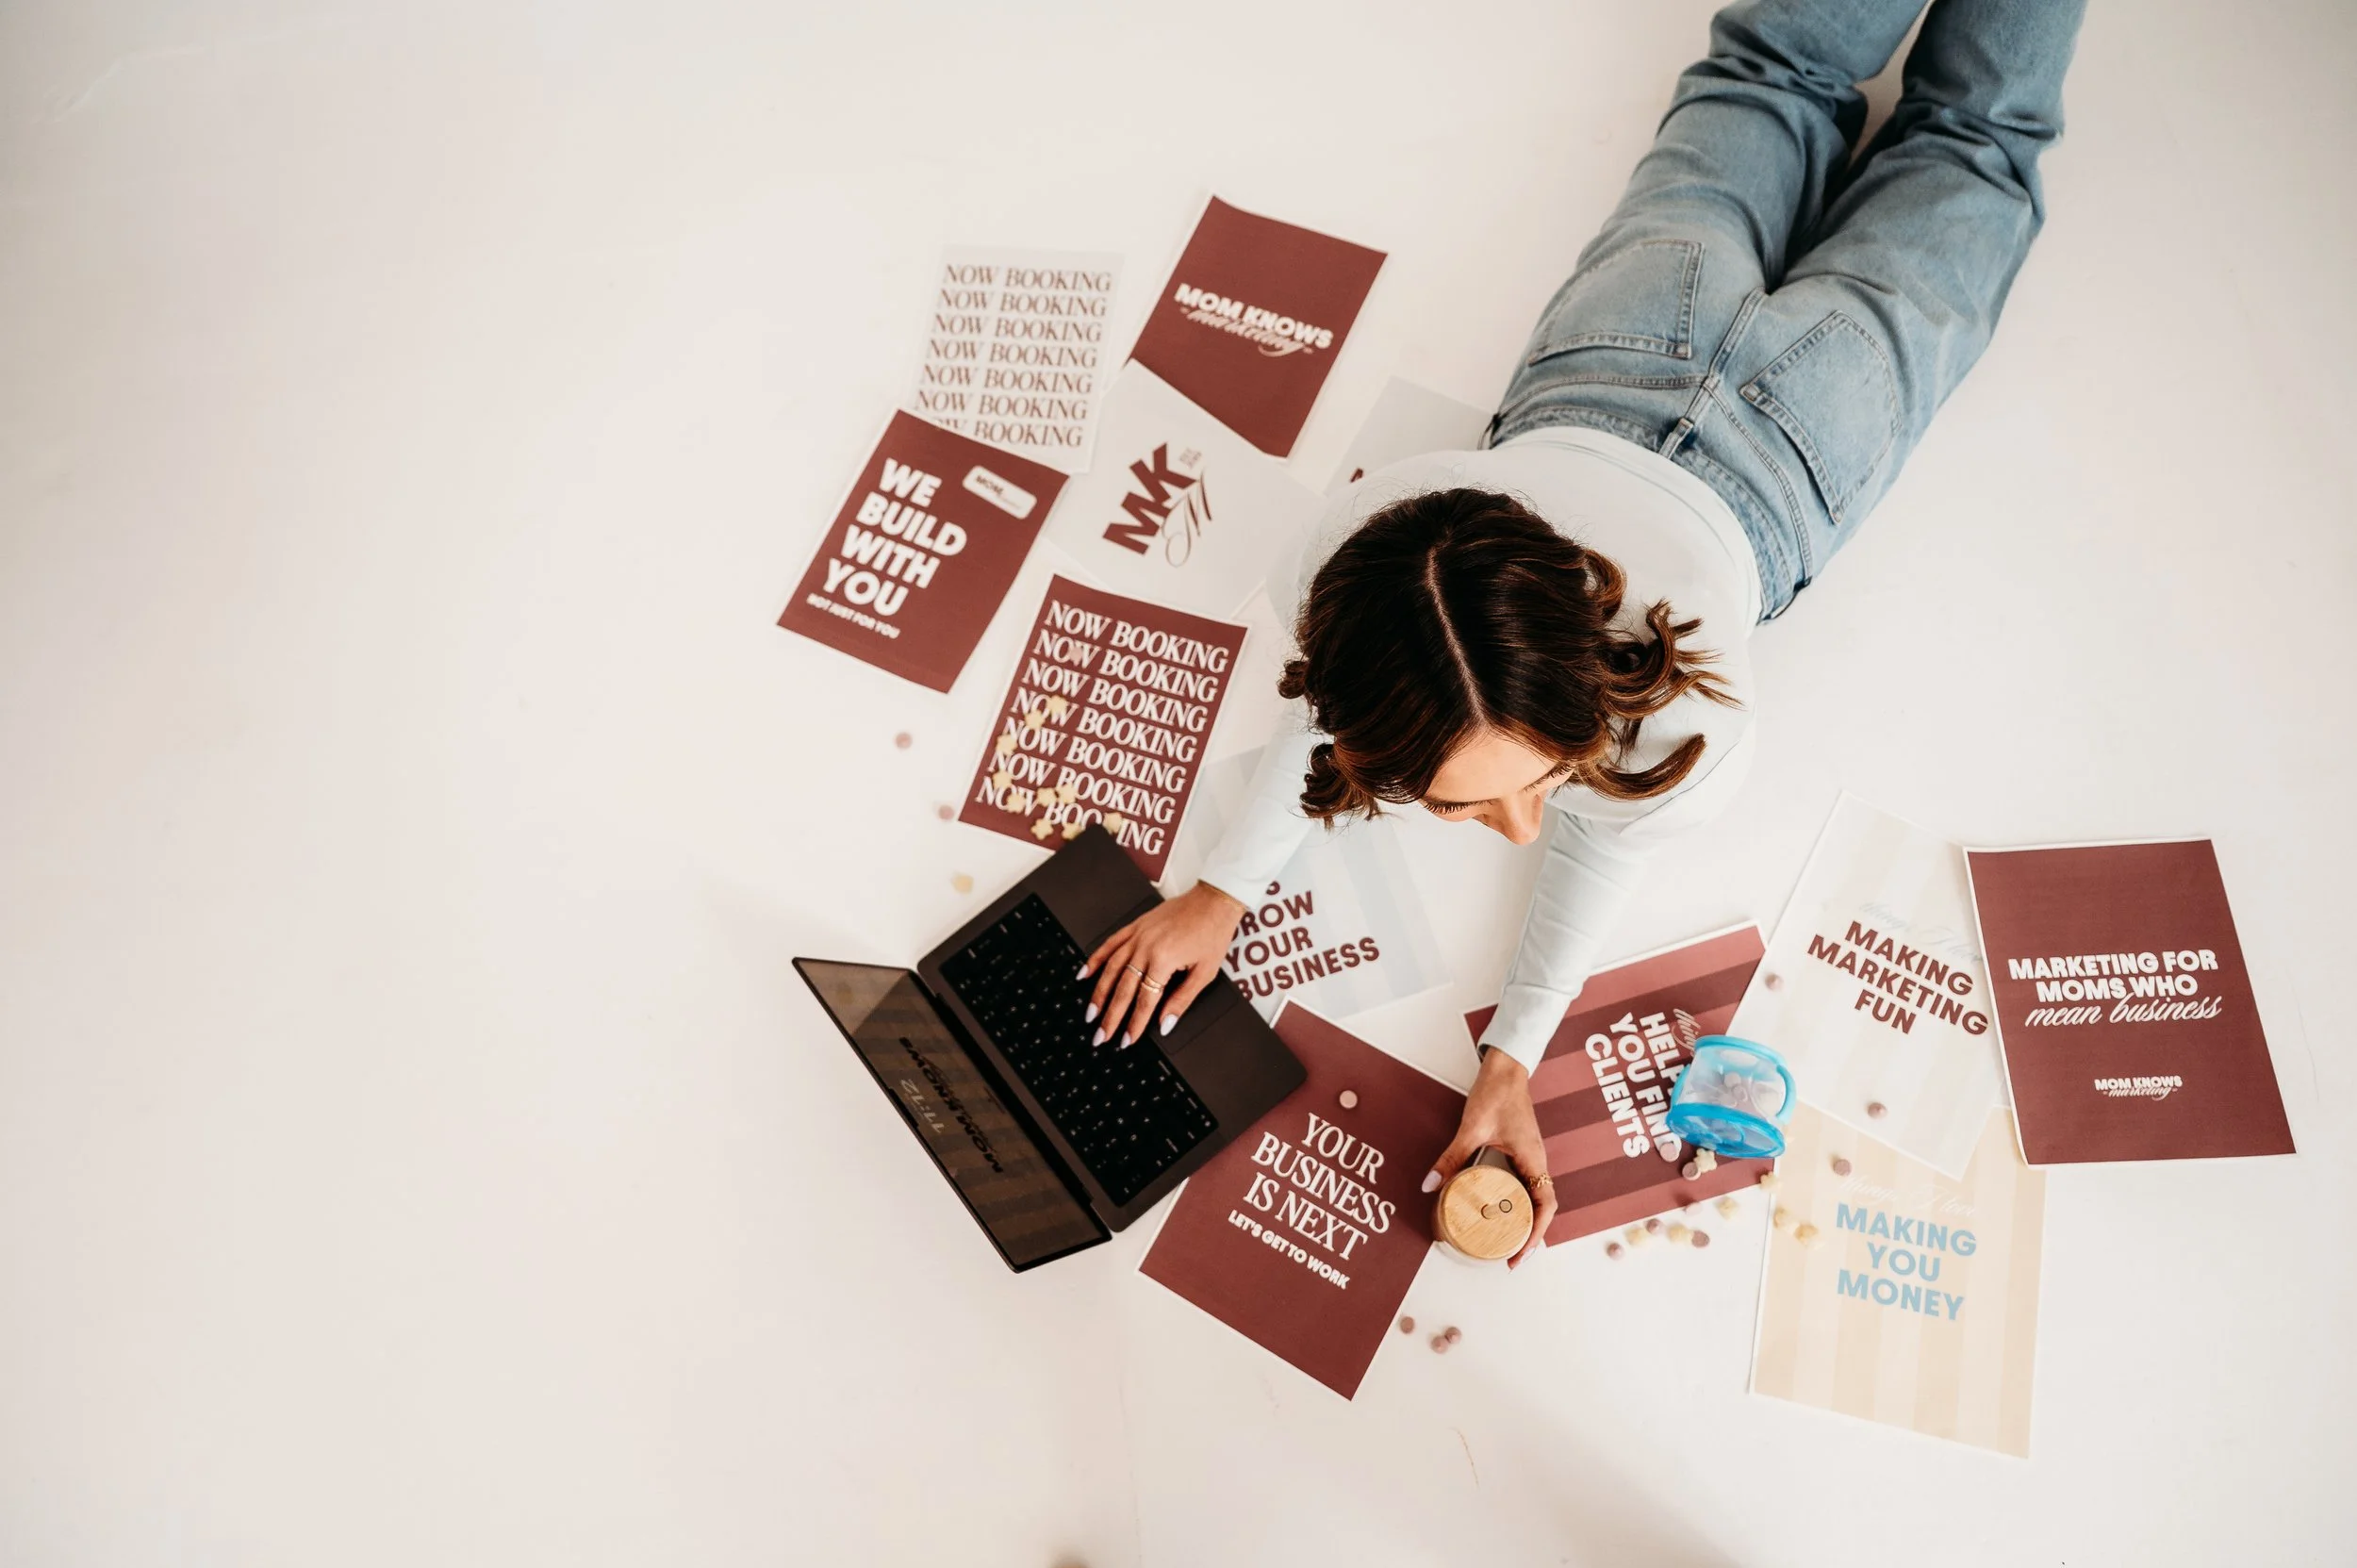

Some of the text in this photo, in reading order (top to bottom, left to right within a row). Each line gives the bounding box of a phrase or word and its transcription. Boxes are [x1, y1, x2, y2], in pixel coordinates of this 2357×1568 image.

[939, 289, 1108, 317] NOW BOOKING
[946, 264, 1112, 292] NOW BOOKING
[933, 314, 1103, 342] NOW BOOKING
[1174, 283, 1334, 350] MOM KNOWS
[921, 365, 1094, 394] NOW BOOKING
[928, 339, 1098, 369] NOW BOOKING
[915, 389, 1089, 421] NOW BOOKING
[878, 457, 943, 507] WE
[1102, 442, 1197, 555] MK
[855, 490, 967, 556] BUILD
[841, 524, 941, 589] WITH
[823, 557, 909, 617] YOU
[806, 593, 831, 612] NOT
[851, 609, 877, 630] FOR
[875, 618, 901, 640] YOU
[1044, 600, 1229, 673] NOW BOOKING
[1033, 628, 1218, 702] NOW BOOKING
[1021, 657, 1208, 733] NOW BOOKING
[1078, 706, 1197, 763] BOOKING
[987, 750, 1057, 786] NOW
[1066, 735, 1186, 793] BOOKING
[1044, 801, 1165, 855] BOOING
[1231, 890, 1314, 942] ROW
[1225, 926, 1313, 973] YOUR
[1232, 936, 1380, 1001] BUSINESS
[1844, 920, 1974, 996] MAKING
[2007, 949, 2218, 981] MARKETING FOR
[1807, 933, 1988, 1035] MARKETING
[1854, 988, 1917, 1034] FUN
[2024, 992, 2222, 1027] mean business
[2036, 974, 2198, 1002] MOMS WHO
[898, 1036, 961, 1113] KNOWS
[1609, 1012, 1656, 1084] YOU
[899, 1079, 945, 1133] 11:12
[1585, 1032, 1651, 1159] CLIENTS
[2093, 1075, 2184, 1091] MOM KNOWS
[2108, 1085, 2173, 1101] marketing
[955, 1114, 1004, 1174] MOM
[1301, 1112, 1386, 1184] YOUR
[1250, 1131, 1396, 1235] BUSINESS
[1243, 1172, 1369, 1262] IS NEXT
[1836, 1202, 1977, 1257] MAKING
[1228, 1209, 1351, 1290] LET'S GET TO WORK
[1867, 1242, 1941, 1282] YOU
[1837, 1268, 1965, 1321] MONEY
